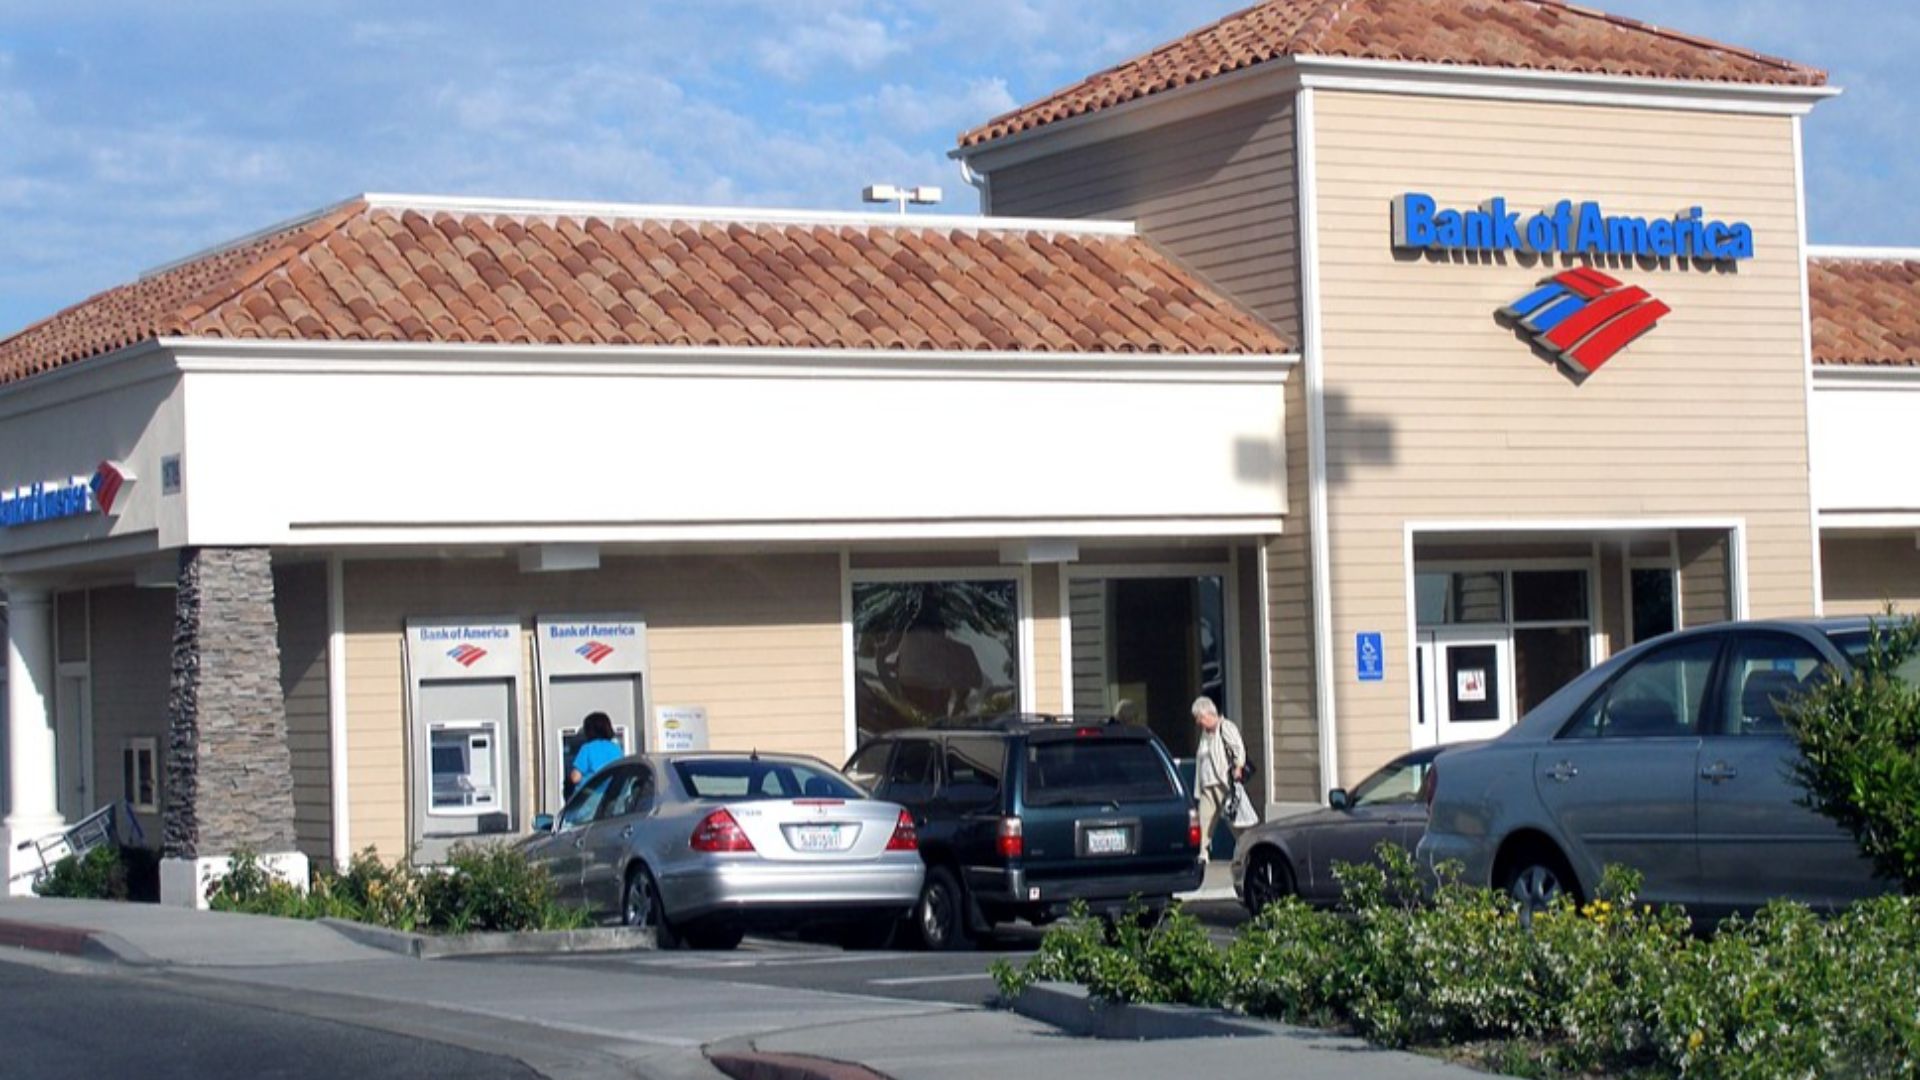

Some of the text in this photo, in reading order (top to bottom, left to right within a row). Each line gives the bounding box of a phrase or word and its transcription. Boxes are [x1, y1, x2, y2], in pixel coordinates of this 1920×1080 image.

[1400, 192, 1754, 259] Bank of America
[420, 626, 510, 641] Bank of America
[550, 623, 636, 638] Bank of America
